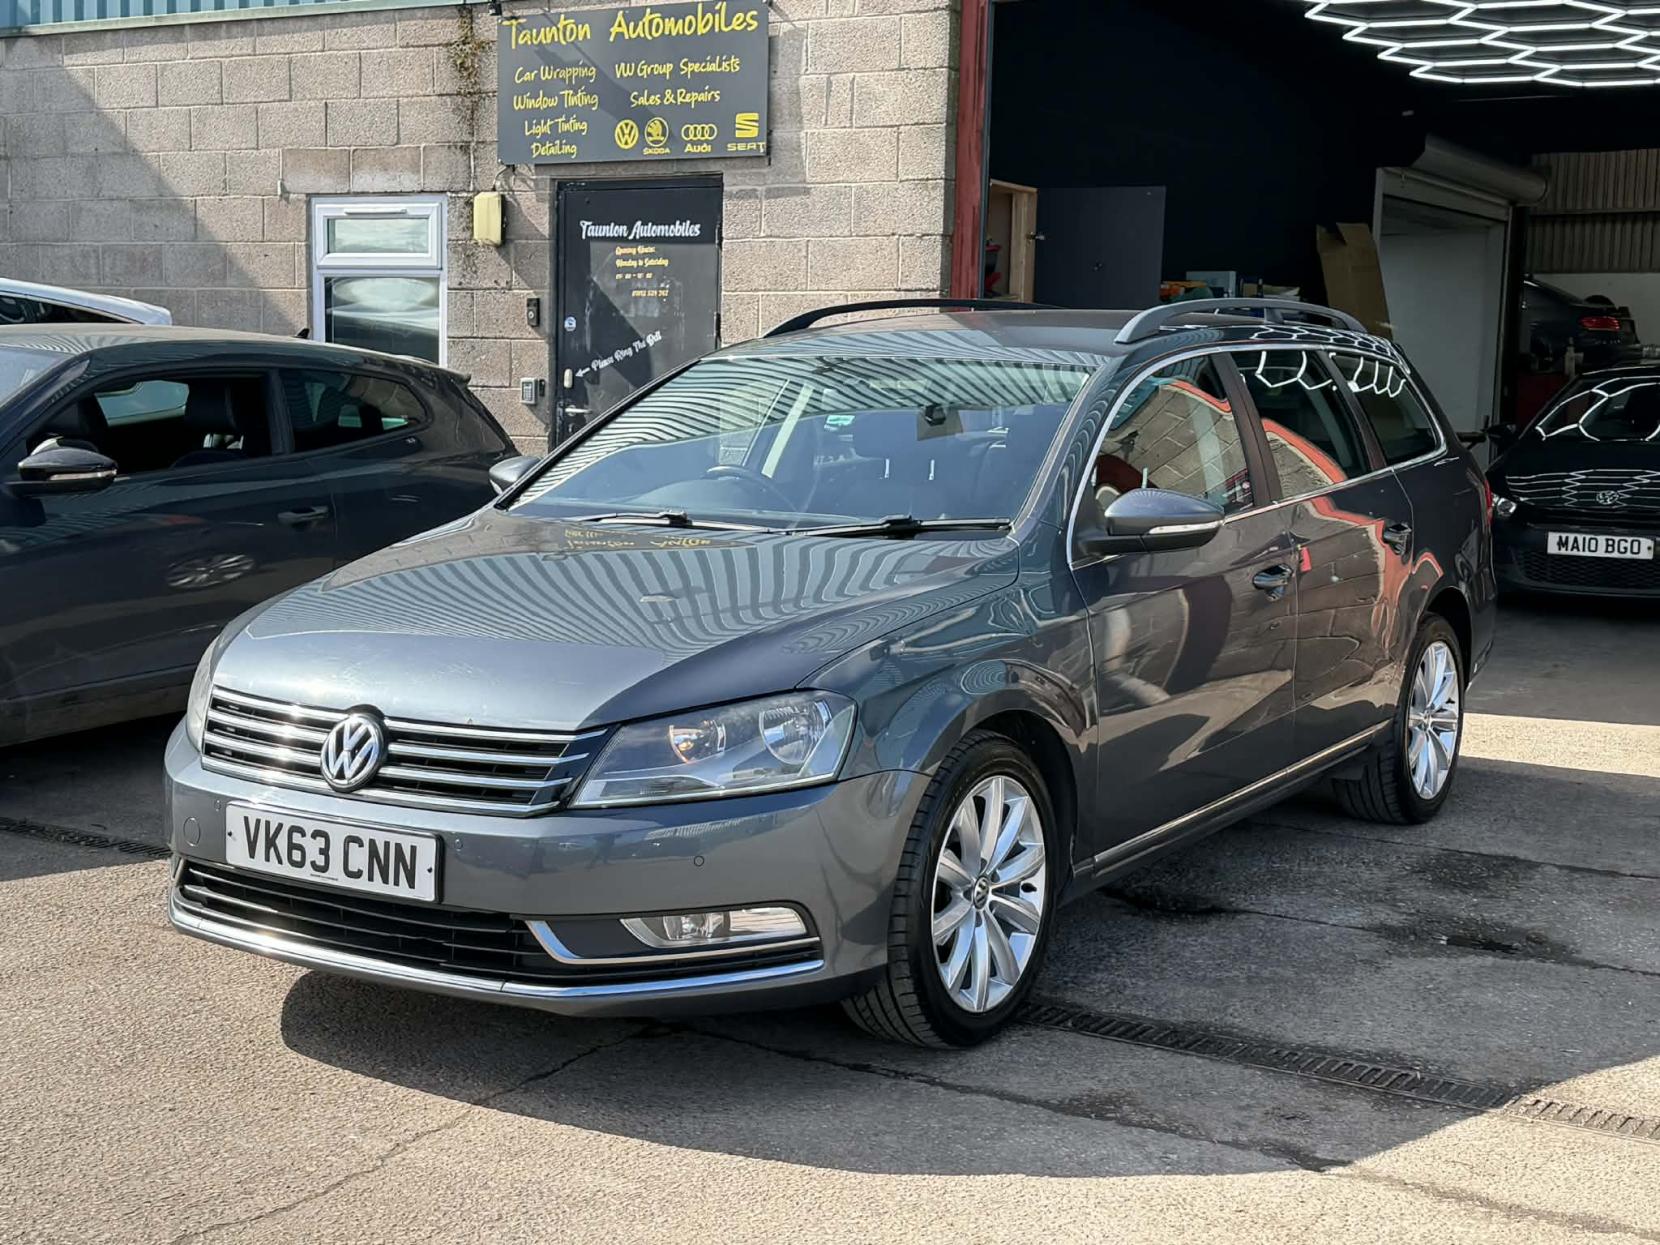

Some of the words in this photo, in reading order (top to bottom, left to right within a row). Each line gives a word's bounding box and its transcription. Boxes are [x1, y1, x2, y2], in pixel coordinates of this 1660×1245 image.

[502, 15, 591, 49] Taunton
[609, 1, 759, 42] Automobiles
[514, 66, 538, 84] Car
[540, 60, 597, 84] Wrapping
[615, 62, 635, 78] VW
[637, 60, 673, 80] Group
[679, 55, 741, 79] Specialists
[513, 90, 558, 110] Window
[559, 85, 599, 110] Tinting
[630, 89, 661, 108] Sales
[663, 88, 677, 105] &
[677, 85, 721, 109] Repairs
[524, 118, 554, 138] Light
[554, 113, 588, 136] Tinting
[530, 139, 578, 158] Detailing
[684, 143, 712, 153] Audi
[727, 141, 766, 153] SEAT
[579, 220, 629, 240] Taunton
[628, 220, 701, 240] Automobiles
[614, 347, 633, 362] Ring
[632, 340, 646, 353] The
[646, 330, 662, 347] Bell
[1556, 535, 1598, 553] MA10
[1604, 538, 1641, 555] BGO
[243, 815, 330, 874] VK63
[342, 834, 418, 890] CNN
